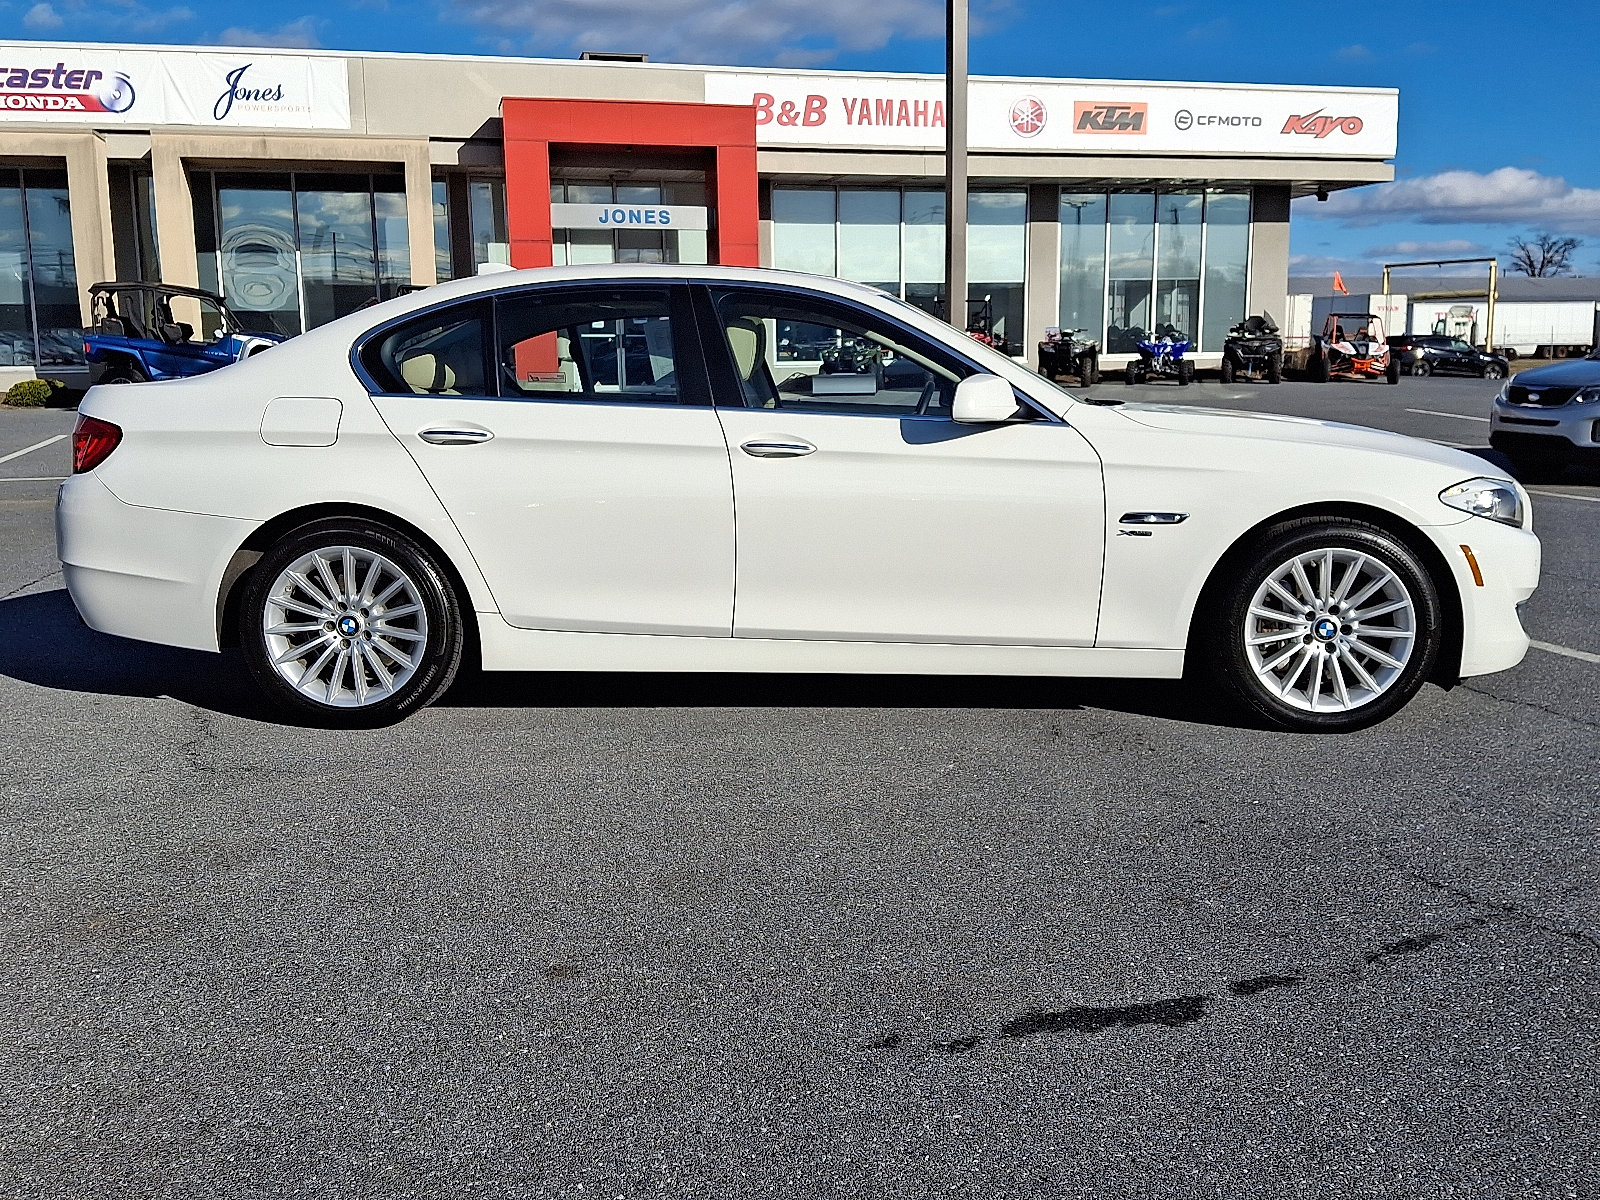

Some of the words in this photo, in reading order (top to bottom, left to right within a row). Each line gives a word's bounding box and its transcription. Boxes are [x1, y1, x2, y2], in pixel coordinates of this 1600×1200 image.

[213, 63, 285, 120] Jones
[753, 92, 828, 127] B&B
[842, 97, 946, 128] YAMAHA
[1076, 105, 1145, 131] KTM
[1197, 115, 1262, 127] CFMOTO
[598, 208, 671, 225] JONES
